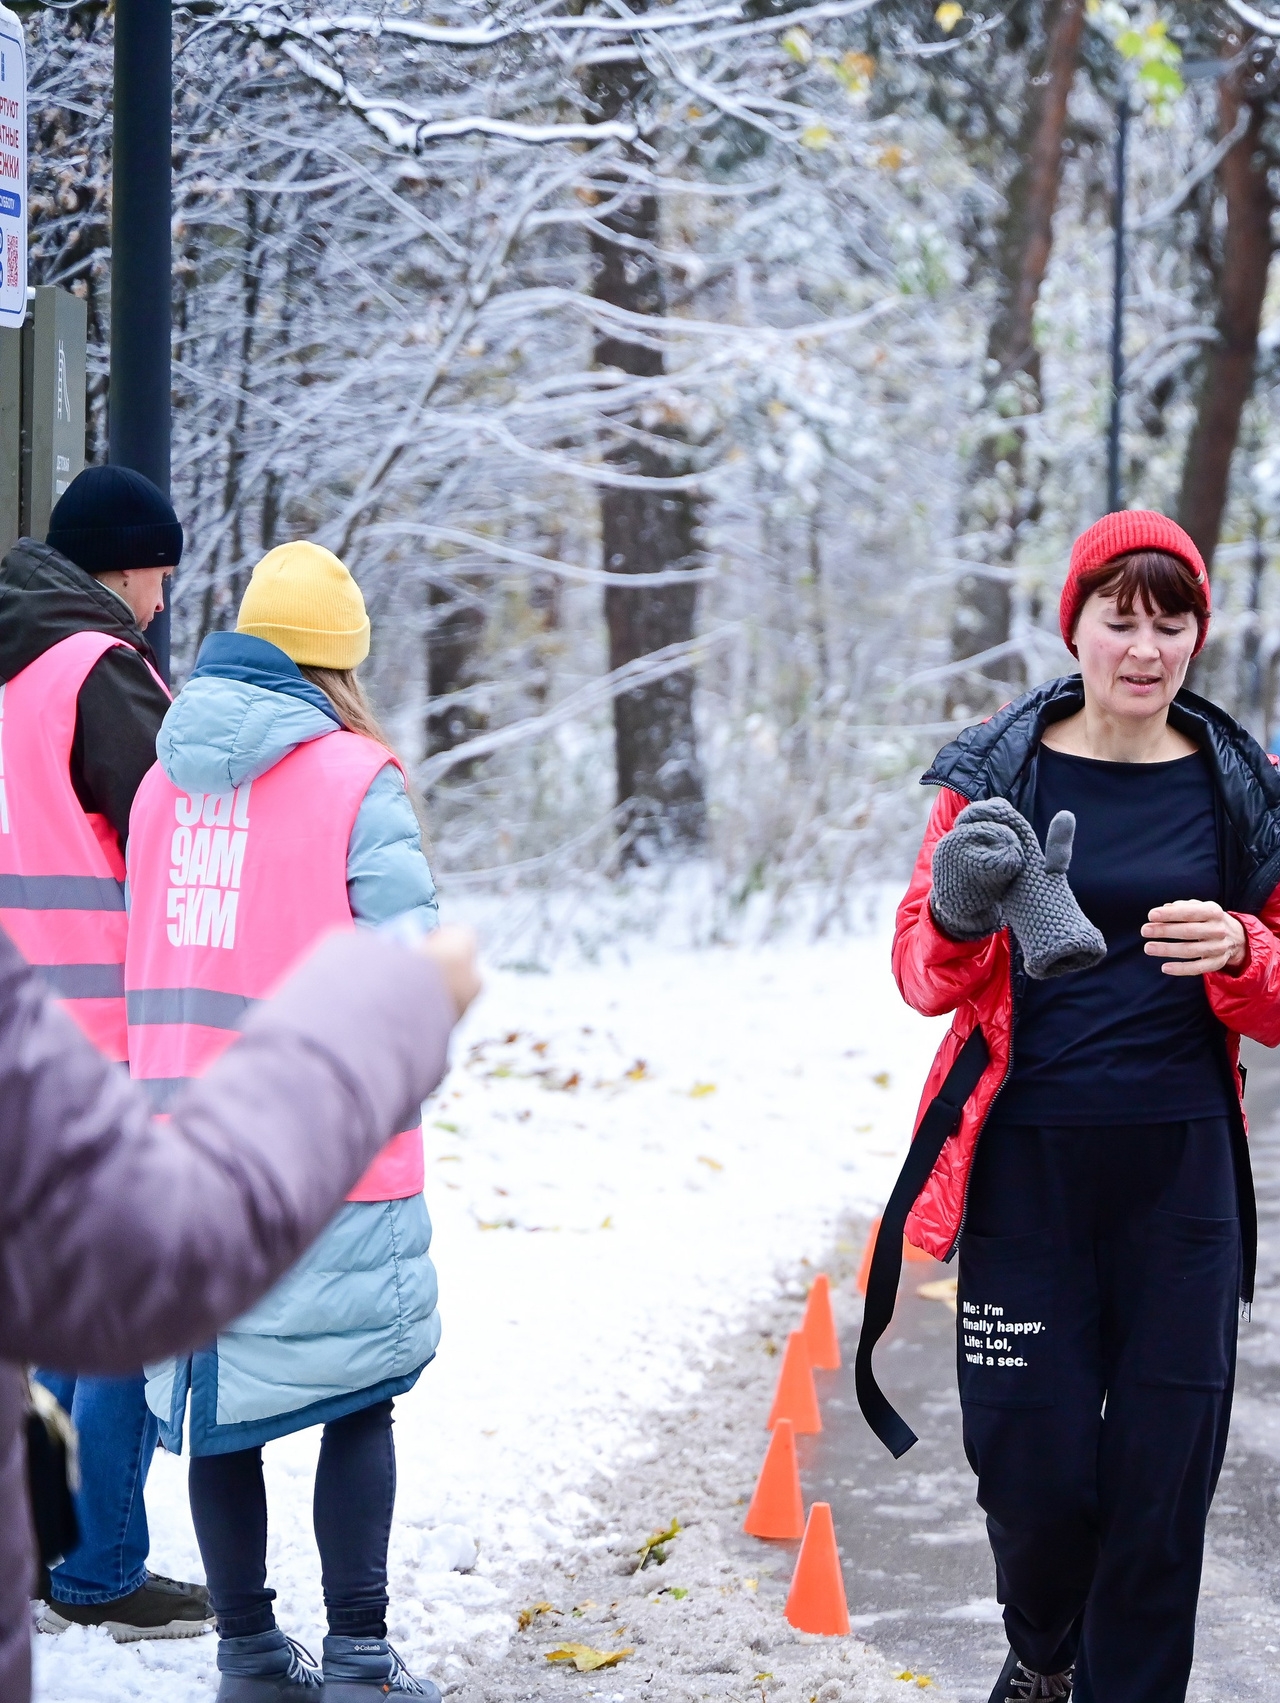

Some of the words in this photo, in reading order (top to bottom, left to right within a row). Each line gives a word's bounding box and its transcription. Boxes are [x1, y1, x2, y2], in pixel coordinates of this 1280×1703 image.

[169, 826, 248, 889] 9AM
[166, 887, 240, 950] 5KM
[962, 1301, 980, 1315] Me:
[984, 1304, 1004, 1316] I'm
[962, 1317, 994, 1334] finally
[997, 1320, 1046, 1335] happy.
[964, 1335, 983, 1348] Life:
[986, 1337, 1012, 1352] Lol,
[965, 1352, 983, 1365] wait
[986, 1357, 994, 1366] a
[997, 1356, 1028, 1367] sec.
